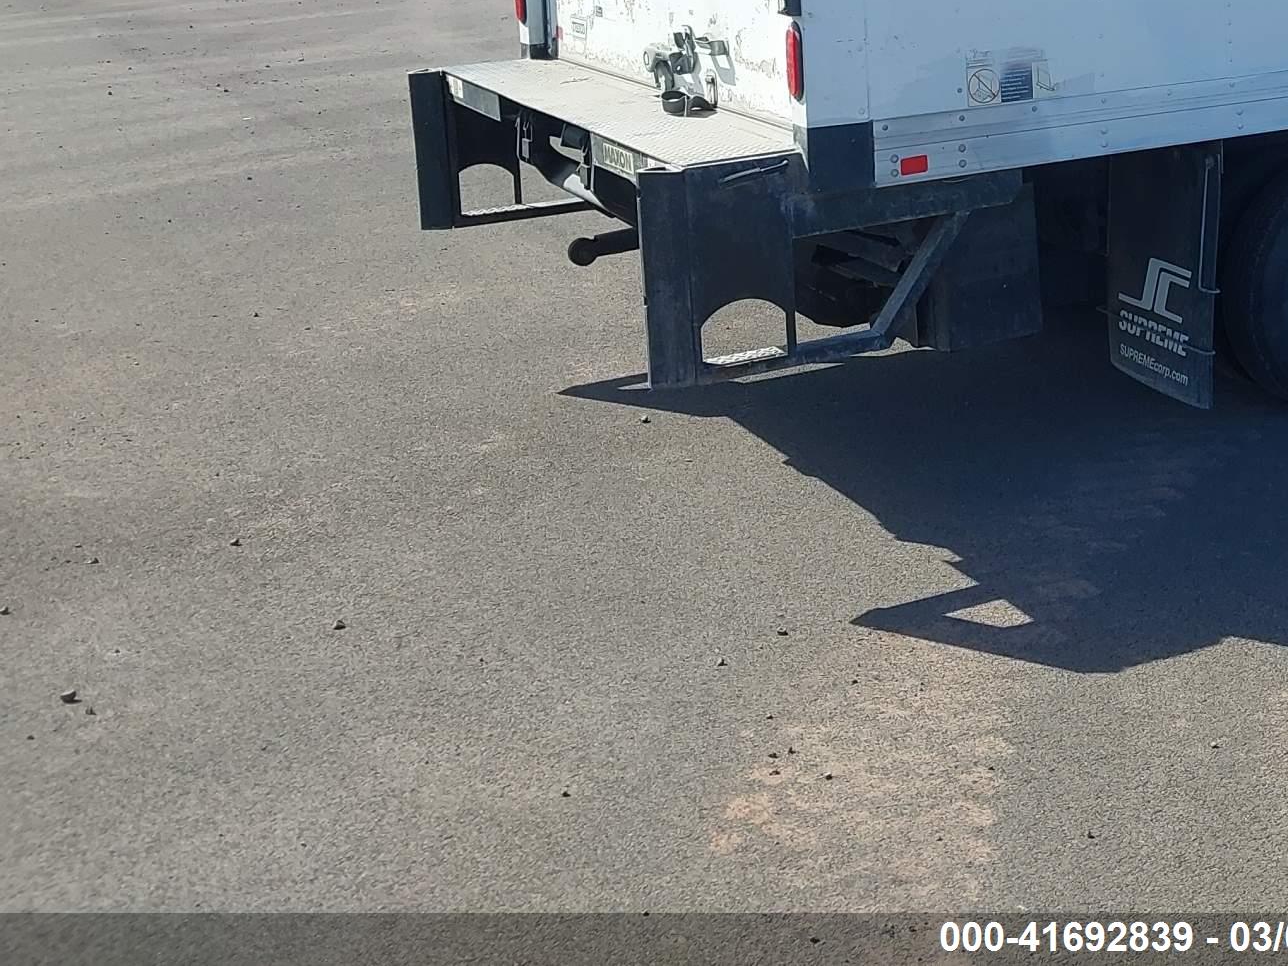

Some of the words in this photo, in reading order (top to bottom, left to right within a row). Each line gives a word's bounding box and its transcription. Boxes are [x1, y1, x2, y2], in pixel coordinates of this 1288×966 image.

[603, 144, 633, 172] MAXON
[1119, 309, 1189, 356] SUPREME
[1119, 343, 1189, 386] SUPREMEcorp.com
